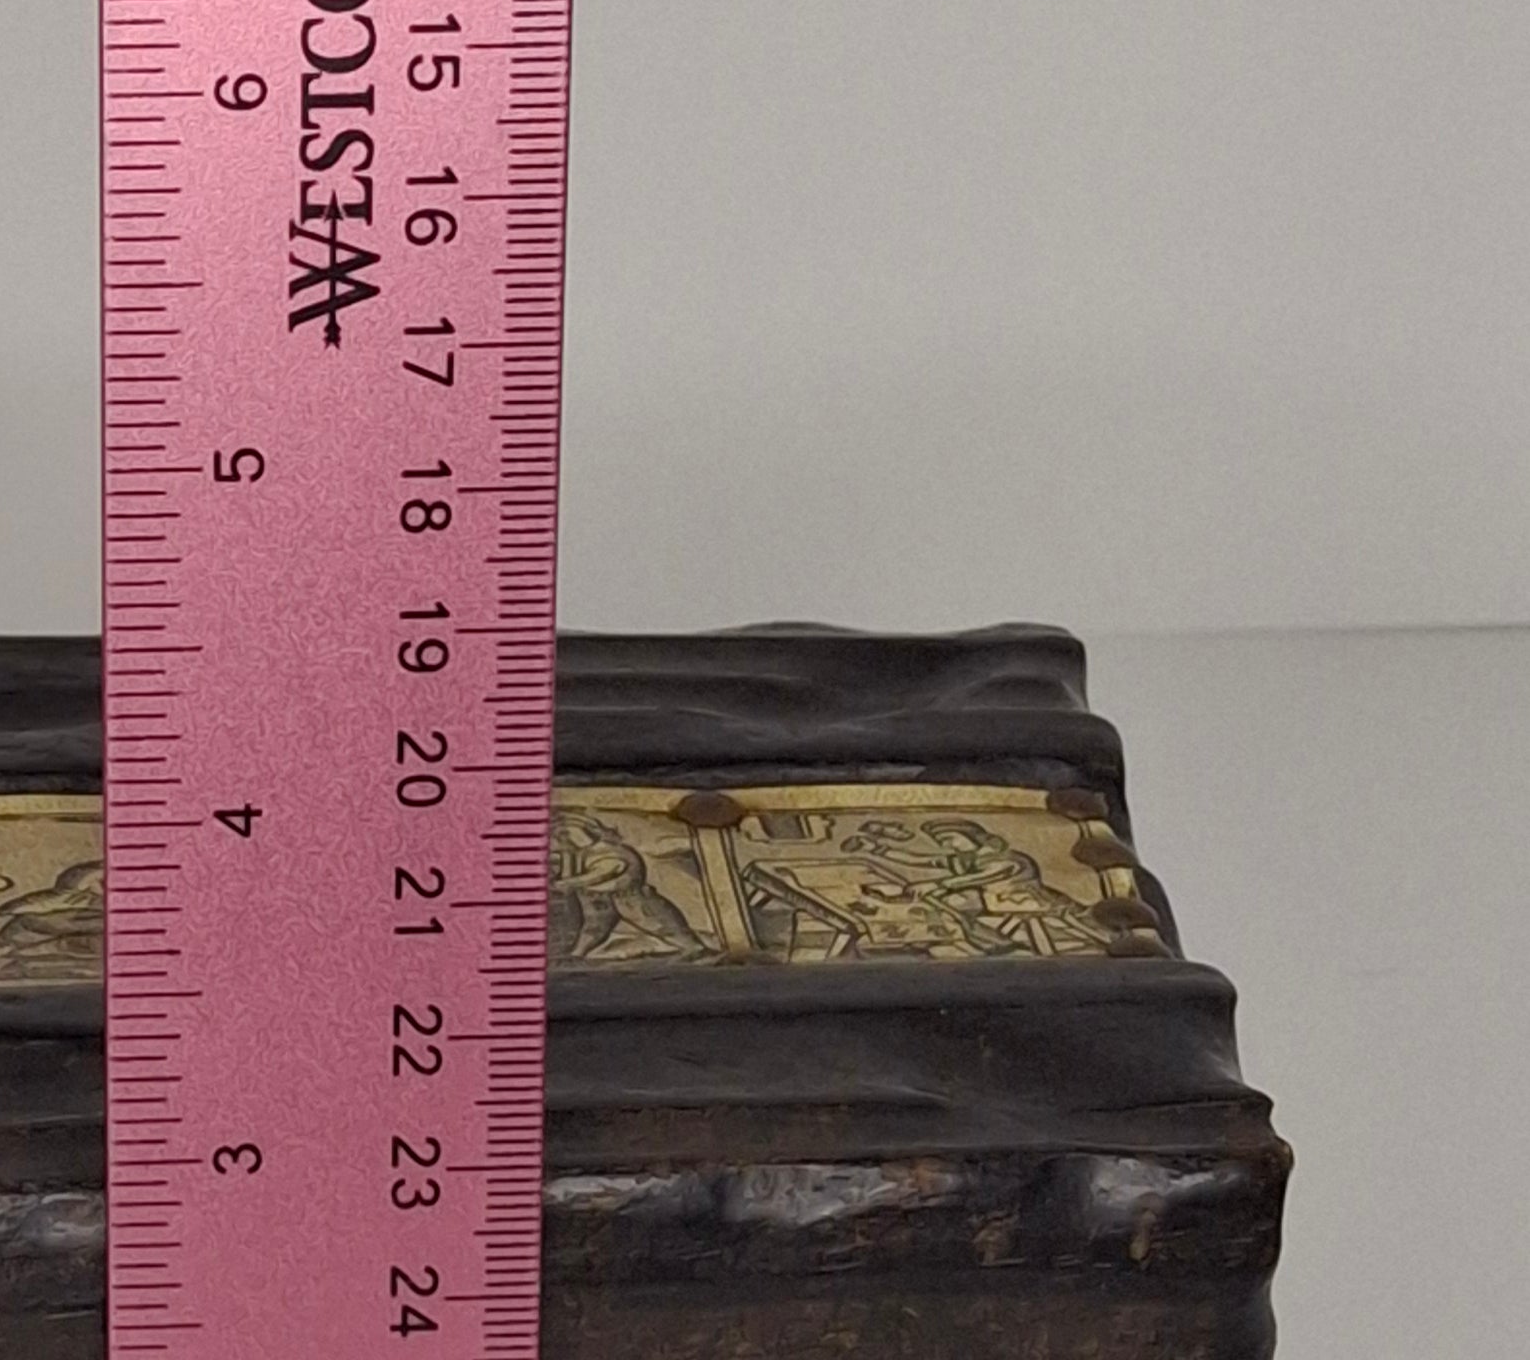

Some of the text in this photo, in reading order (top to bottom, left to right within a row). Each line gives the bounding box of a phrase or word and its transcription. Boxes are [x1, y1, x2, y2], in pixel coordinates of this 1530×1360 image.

[406, 12, 463, 93] 15
[212, 72, 269, 112] 6
[403, 165, 461, 247] 16
[401, 316, 457, 388] 17
[212, 446, 266, 485] 5
[398, 458, 454, 535] 18
[396, 600, 452, 674] 19
[394, 729, 450, 809] 20
[211, 802, 264, 839] 4
[392, 865, 447, 937] 21
[391, 1003, 444, 1078] 22
[211, 1142, 264, 1176] 3
[389, 1134, 443, 1211] 23
[388, 1264, 441, 1339] 24
